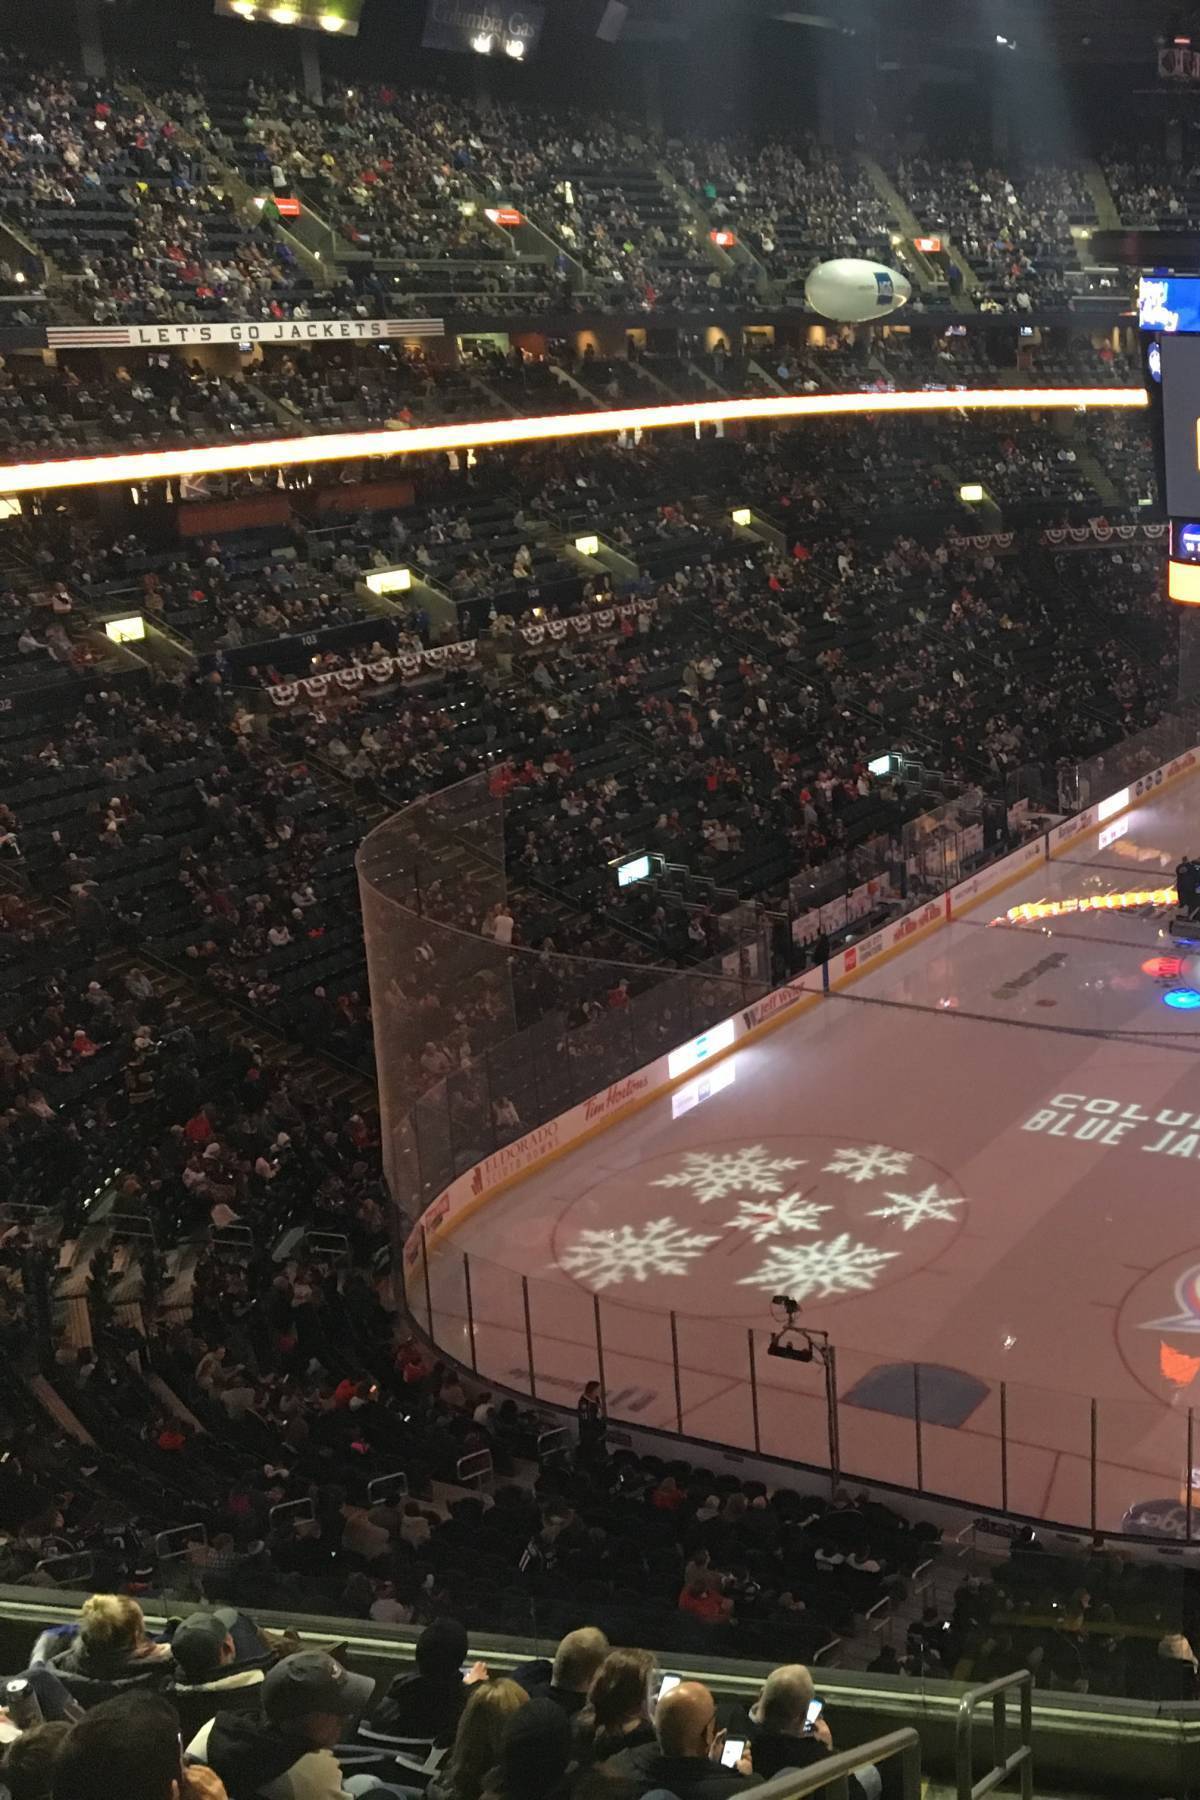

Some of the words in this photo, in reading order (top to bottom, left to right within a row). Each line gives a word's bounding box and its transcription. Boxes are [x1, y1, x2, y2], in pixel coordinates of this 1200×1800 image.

[138, 327, 212, 343] LET'S
[231, 326, 260, 340] GO
[274, 323, 381, 339] JACKETS
[302, 635, 318, 646] 103
[584, 1094, 605, 1120] Tim
[607, 1076, 648, 1108] Hortons
[1020, 1109, 1137, 1145] BLUE
[484, 1121, 559, 1172] ELDORADO
